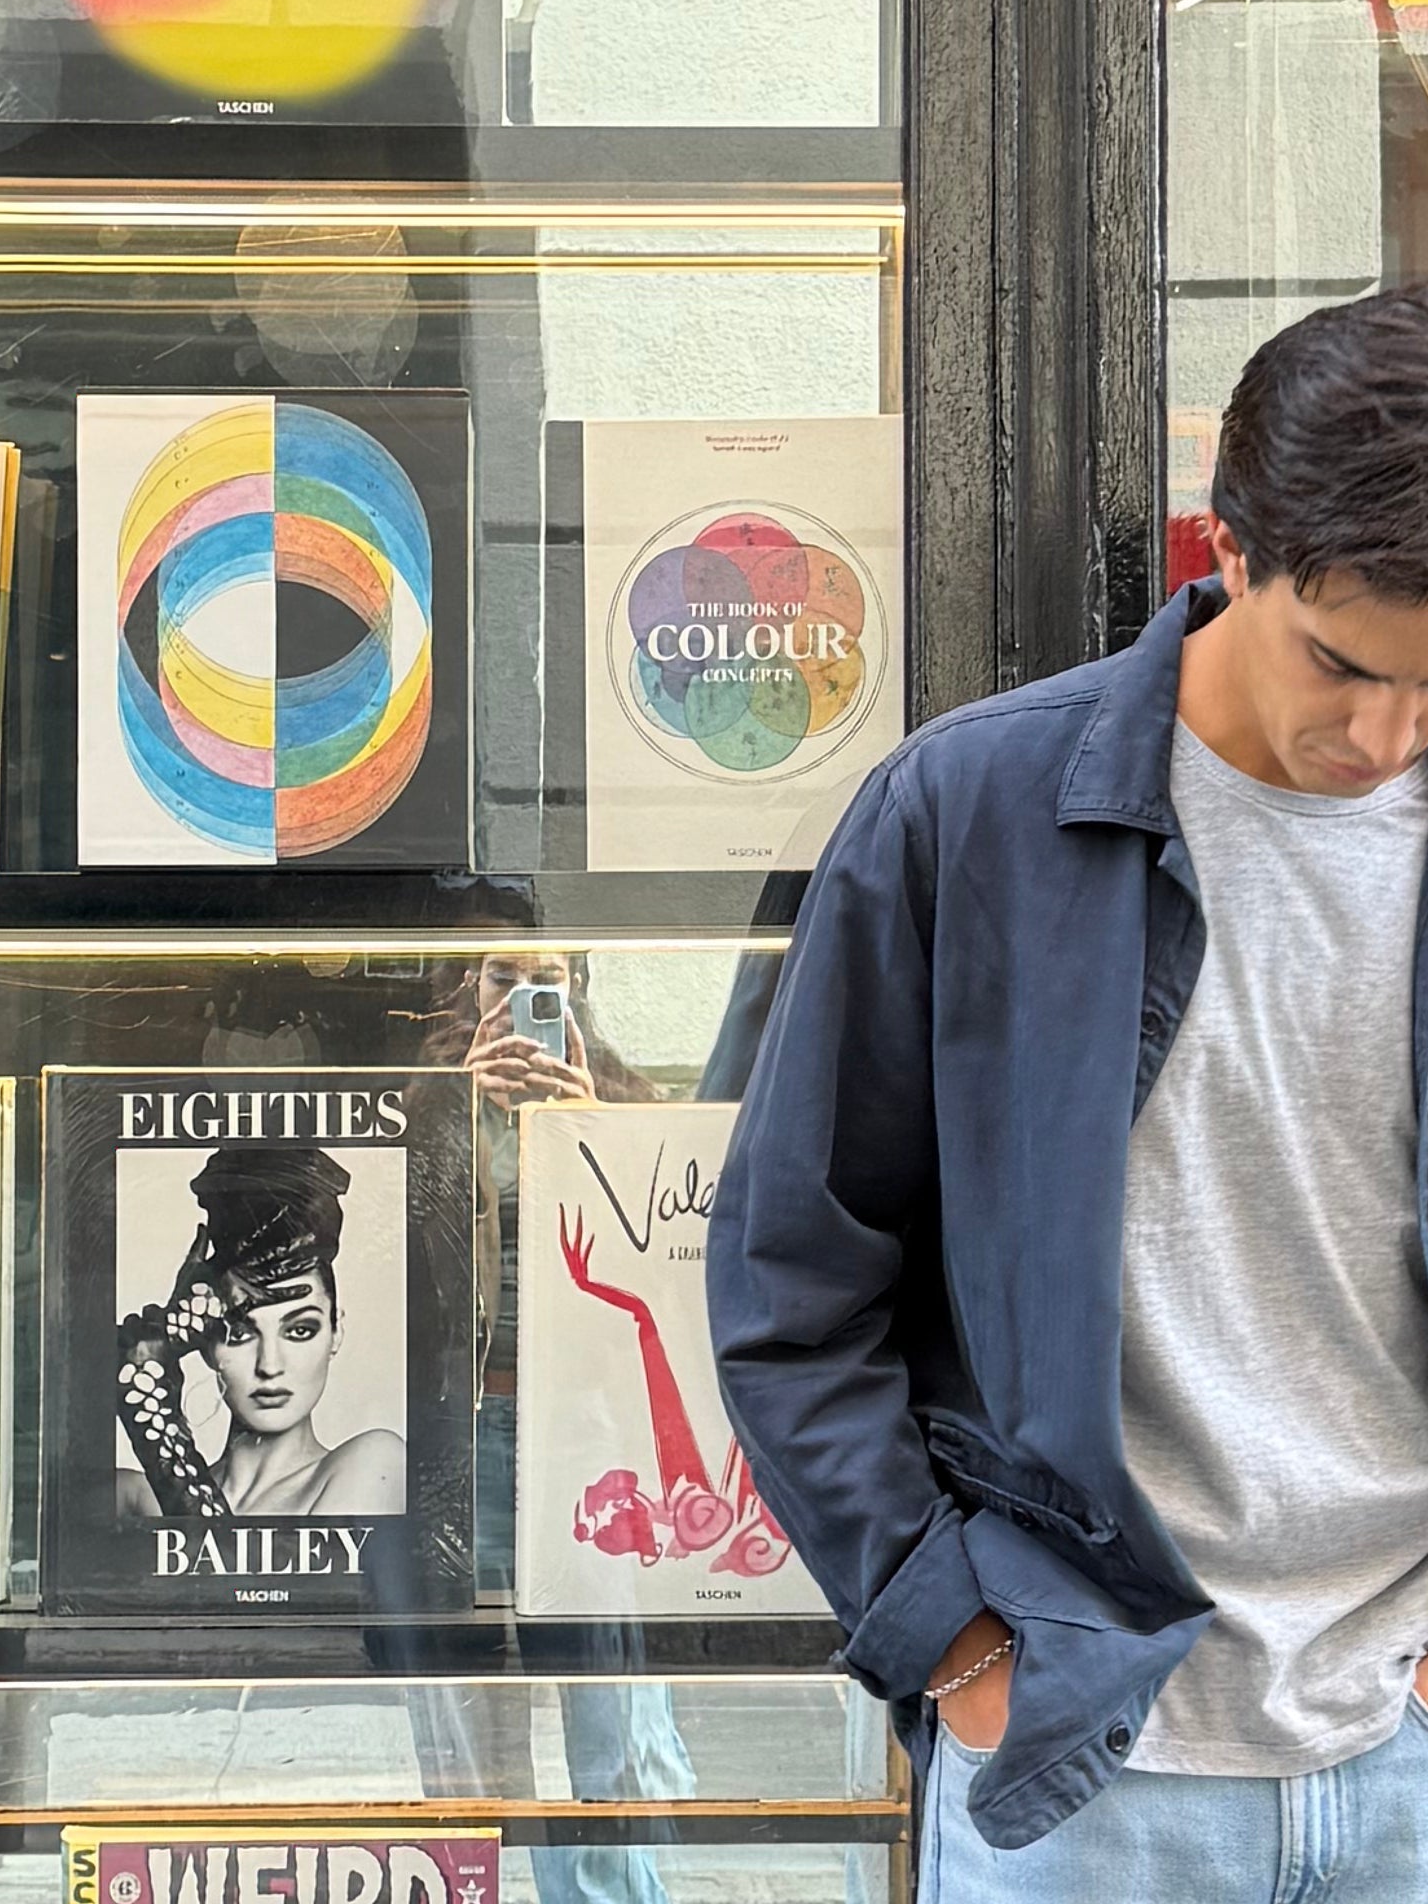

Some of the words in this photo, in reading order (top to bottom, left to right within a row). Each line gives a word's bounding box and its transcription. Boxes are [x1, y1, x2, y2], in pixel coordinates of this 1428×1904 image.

[687, 603, 724, 618] THE
[728, 602, 779, 618] BOOK
[647, 623, 850, 663] COLOUR
[702, 667, 794, 684] CONCEPTS
[116, 1089, 408, 1140] EIGHTIES
[151, 1526, 375, 1577] BAILEY
[234, 1590, 289, 1603] TASCHEN
